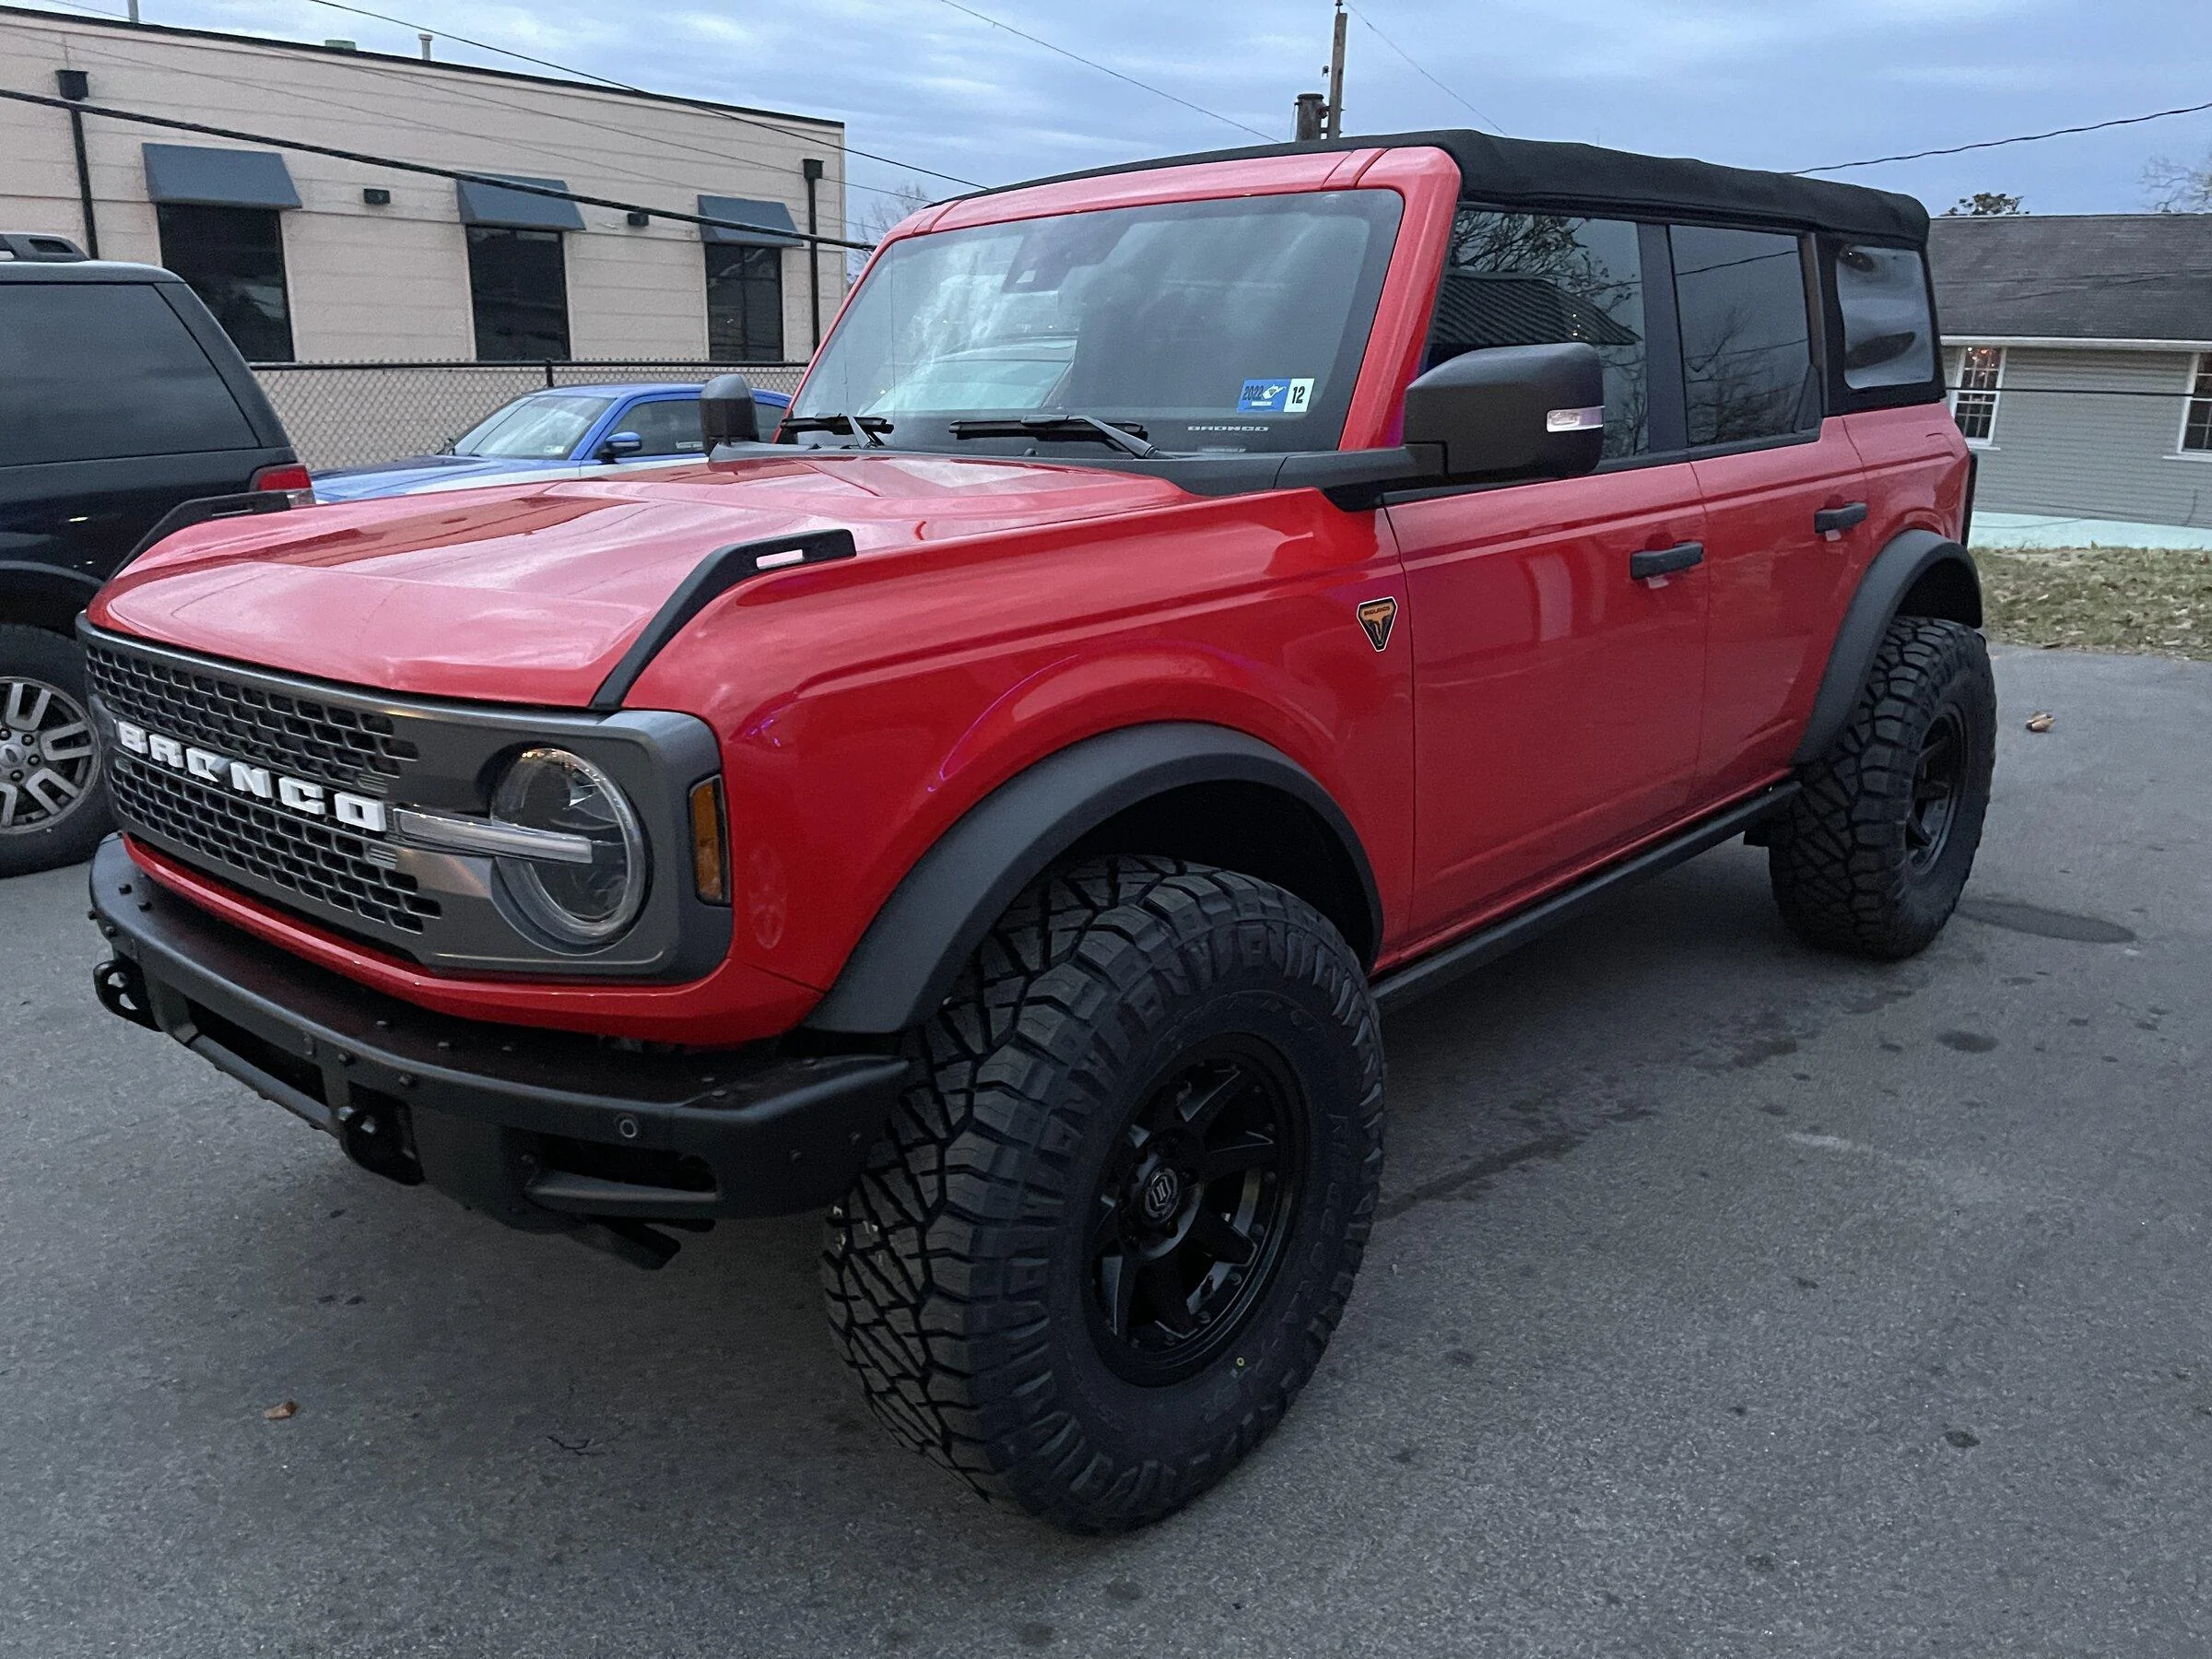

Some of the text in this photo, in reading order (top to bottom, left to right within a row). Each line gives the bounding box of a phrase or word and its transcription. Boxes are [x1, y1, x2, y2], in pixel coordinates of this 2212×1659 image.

[1241, 385, 1265, 401] 2022
[1291, 385, 1306, 404] 12
[115, 720, 386, 832] BRONCO
